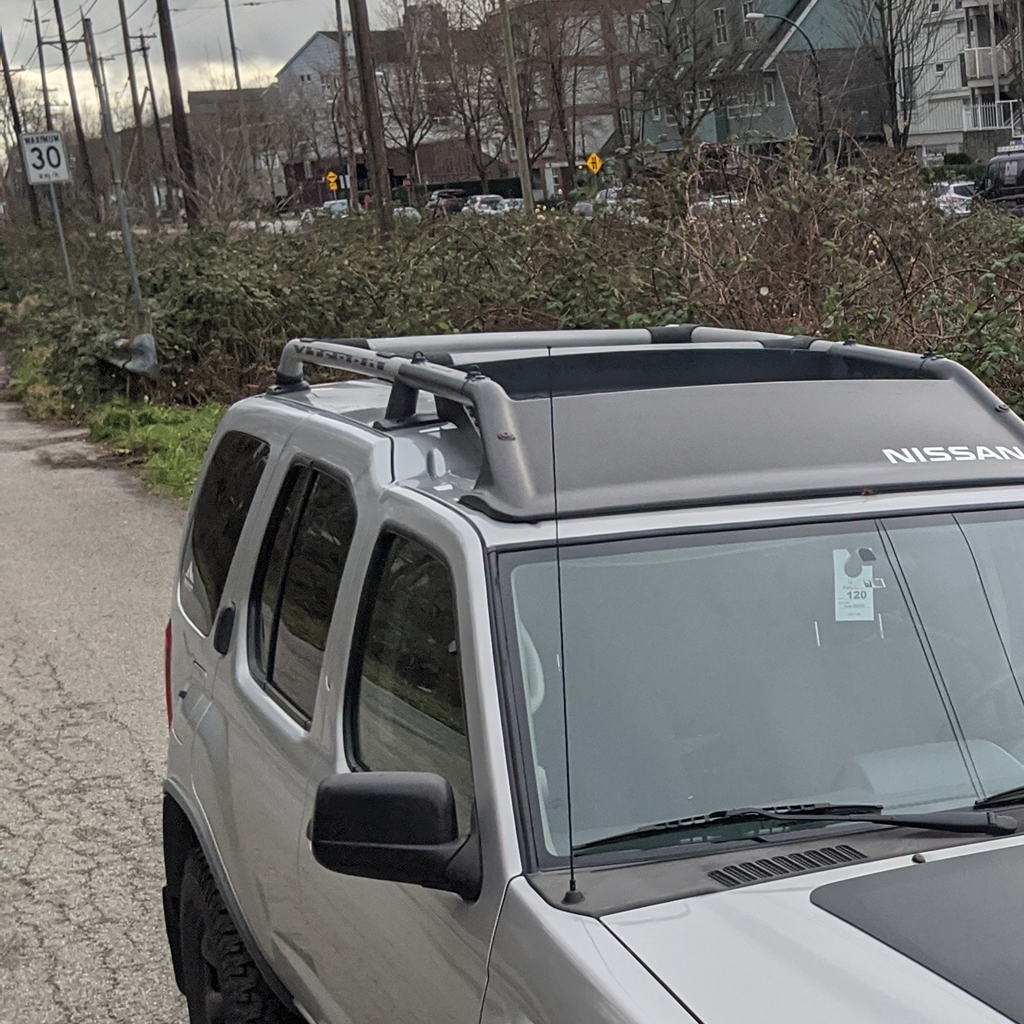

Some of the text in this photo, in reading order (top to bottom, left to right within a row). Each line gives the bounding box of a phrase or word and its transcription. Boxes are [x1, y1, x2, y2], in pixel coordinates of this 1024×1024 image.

[24, 134, 60, 145] MAXIMUM
[30, 145, 61, 170] 30
[847, 590, 867, 600] 120
